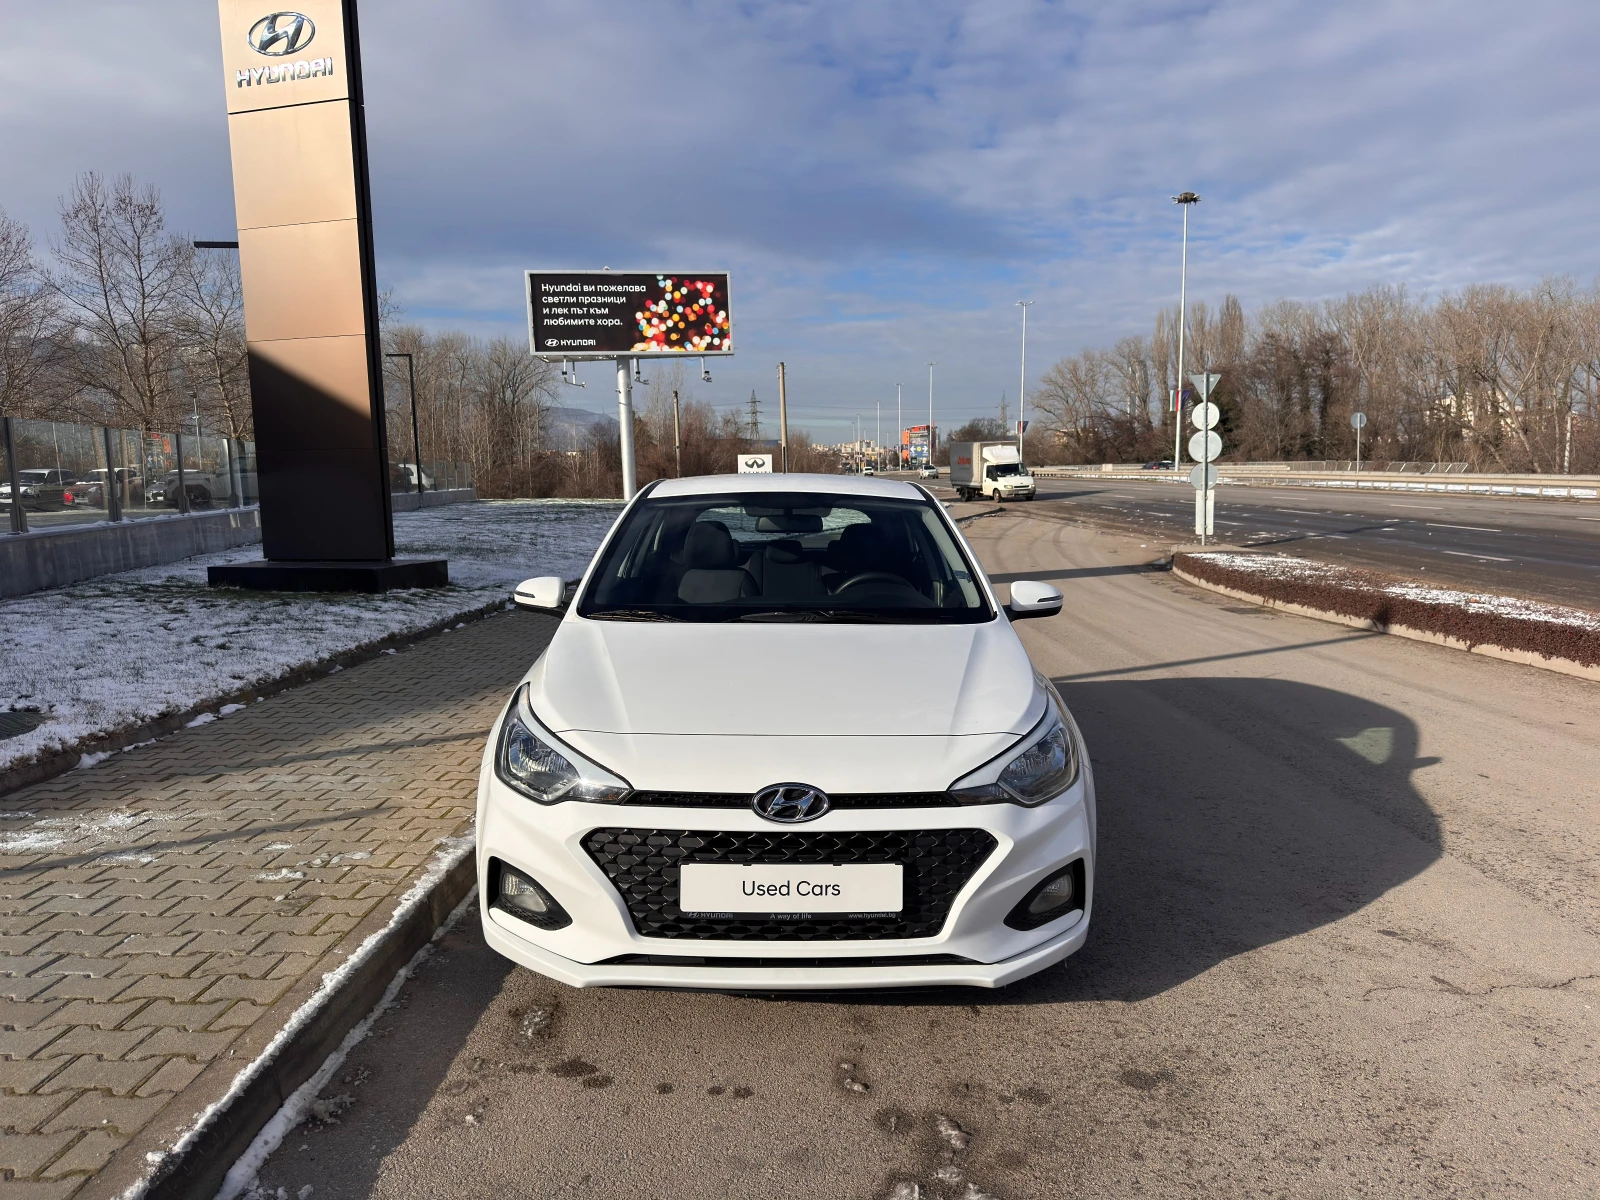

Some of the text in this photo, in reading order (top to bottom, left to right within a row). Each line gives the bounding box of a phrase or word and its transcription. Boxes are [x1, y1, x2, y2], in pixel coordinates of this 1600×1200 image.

[236, 57, 333, 88] HYUNDAI
[541, 283, 647, 294] Hyundai ви пожелава
[542, 296, 627, 305] светли празници
[543, 307, 609, 315] и лек път към
[543, 317, 623, 327] любимите хора.
[742, 880, 841, 897] Used Cars
